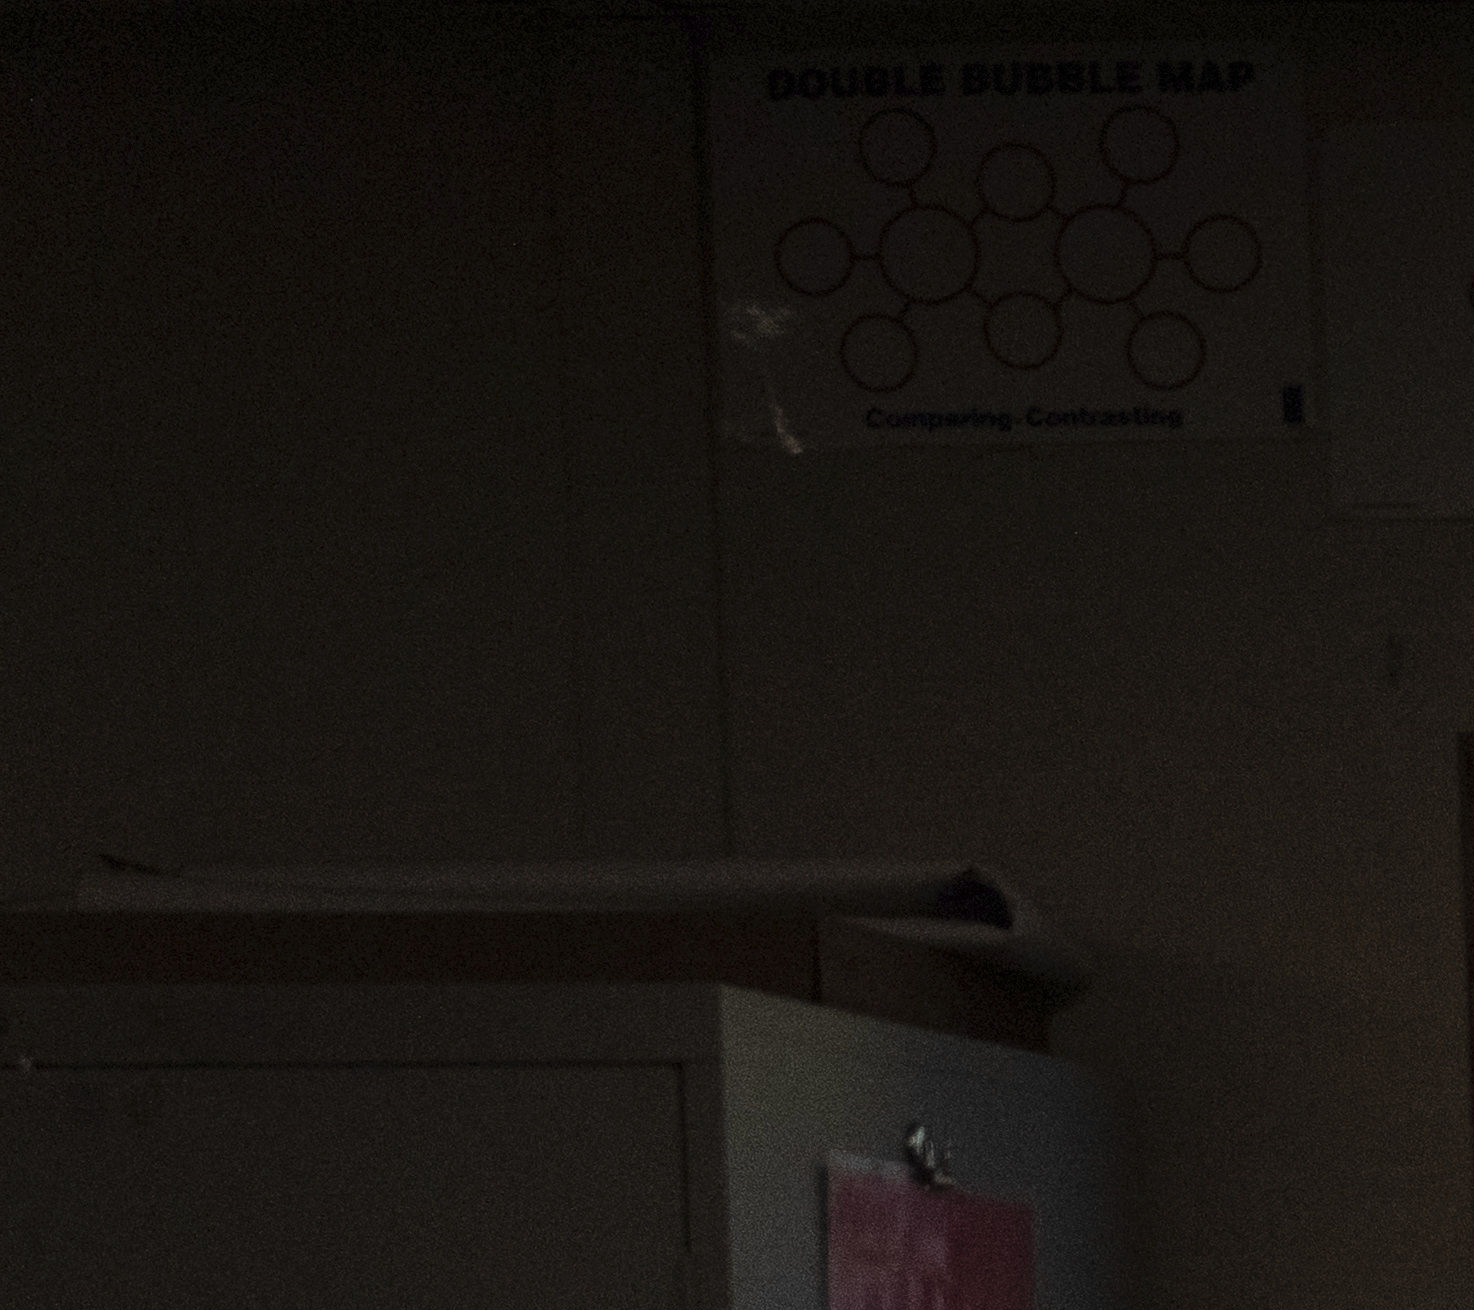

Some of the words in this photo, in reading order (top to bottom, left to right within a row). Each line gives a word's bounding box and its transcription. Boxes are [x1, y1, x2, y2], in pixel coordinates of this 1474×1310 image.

[766, 62, 945, 101] DOUBLE
[960, 61, 1142, 96] BUBBLE
[1157, 60, 1254, 93] MAP
